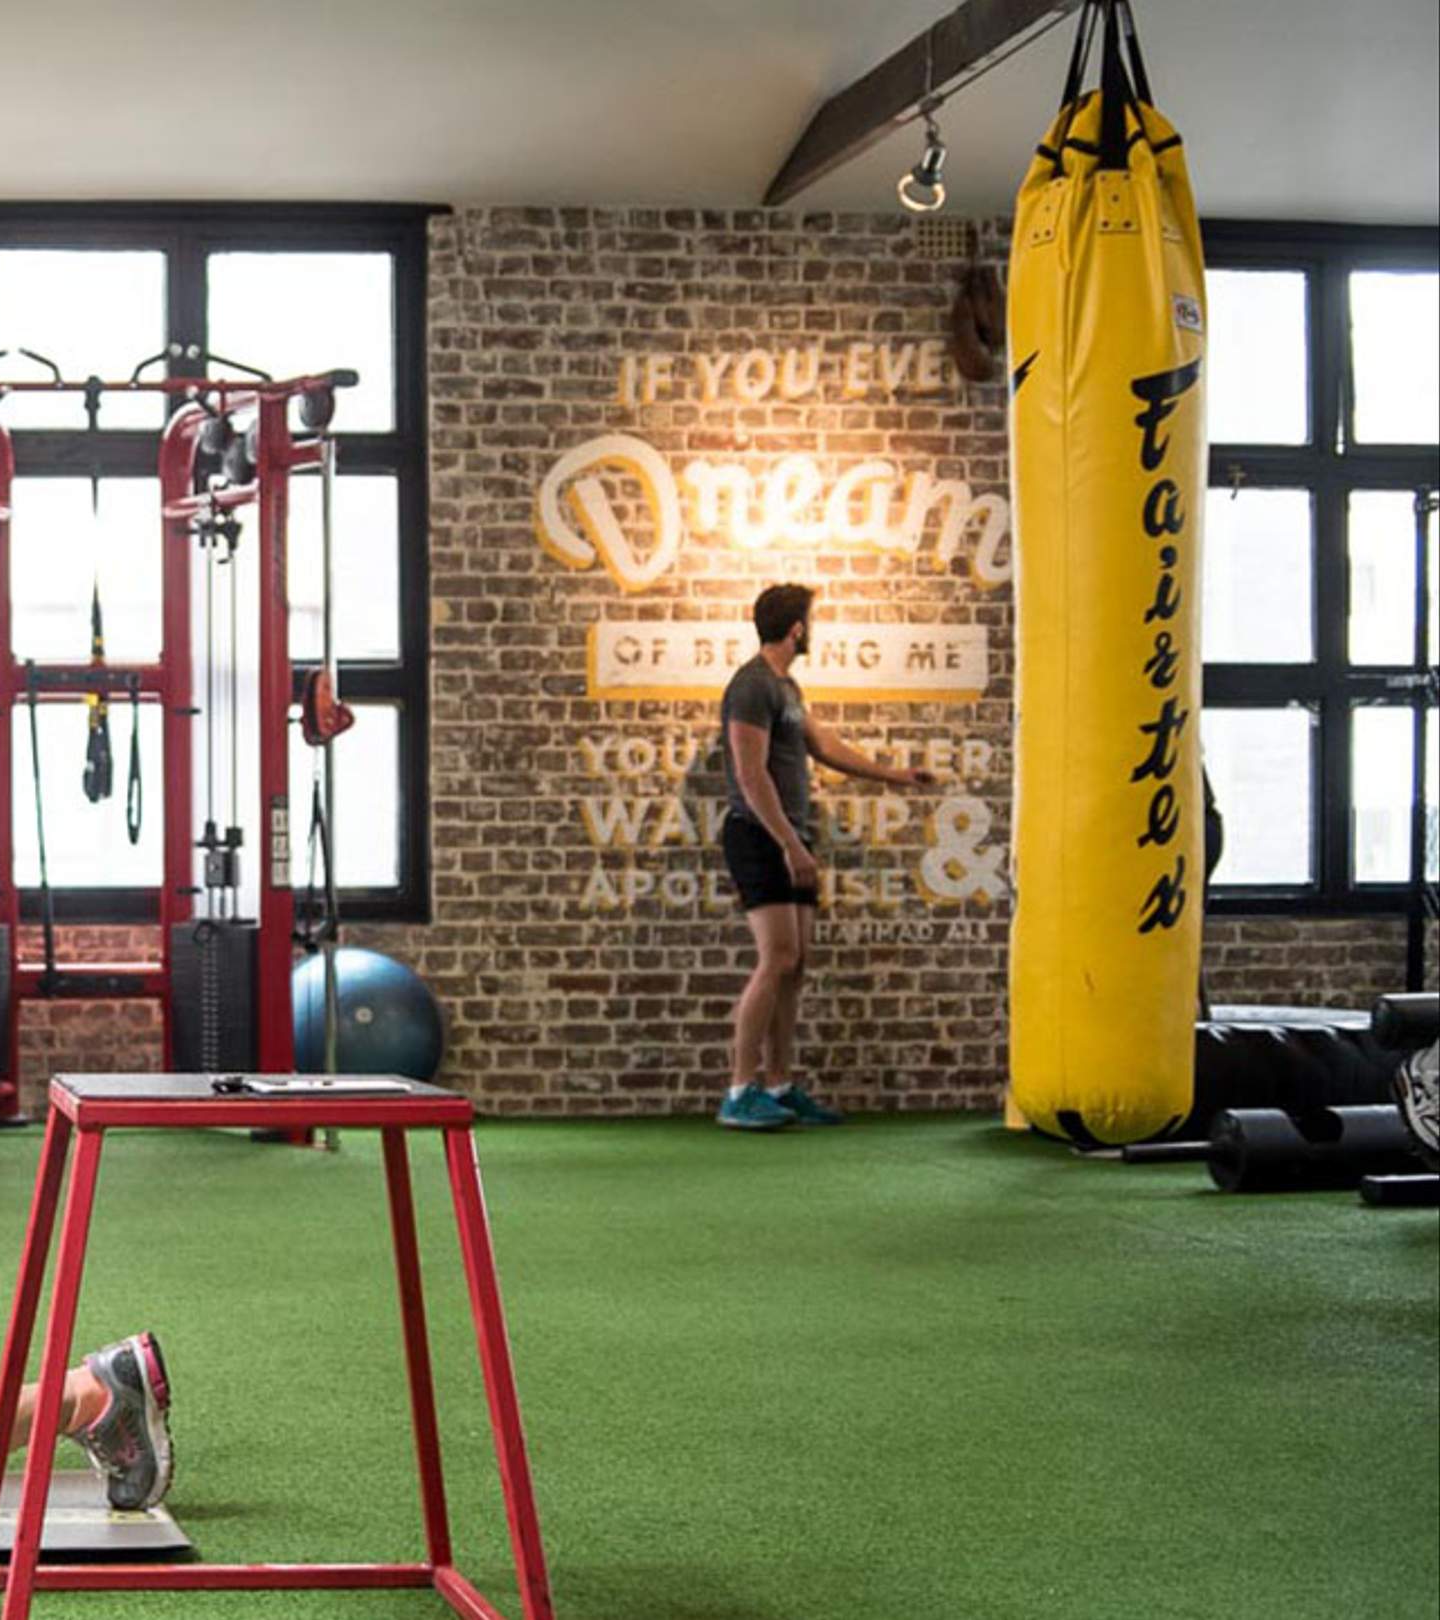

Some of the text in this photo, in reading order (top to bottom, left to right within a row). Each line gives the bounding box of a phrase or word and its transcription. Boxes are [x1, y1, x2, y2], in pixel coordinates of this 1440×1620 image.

[618, 354, 674, 405] IF
[694, 346, 820, 404] YOU
[535, 434, 1012, 594] Dream
[613, 635, 963, 670] OF BENG ME
[581, 797, 1009, 906] WAK UP &
[579, 868, 910, 911] APOLISE
[815, 920, 934, 942] HAMMAD
